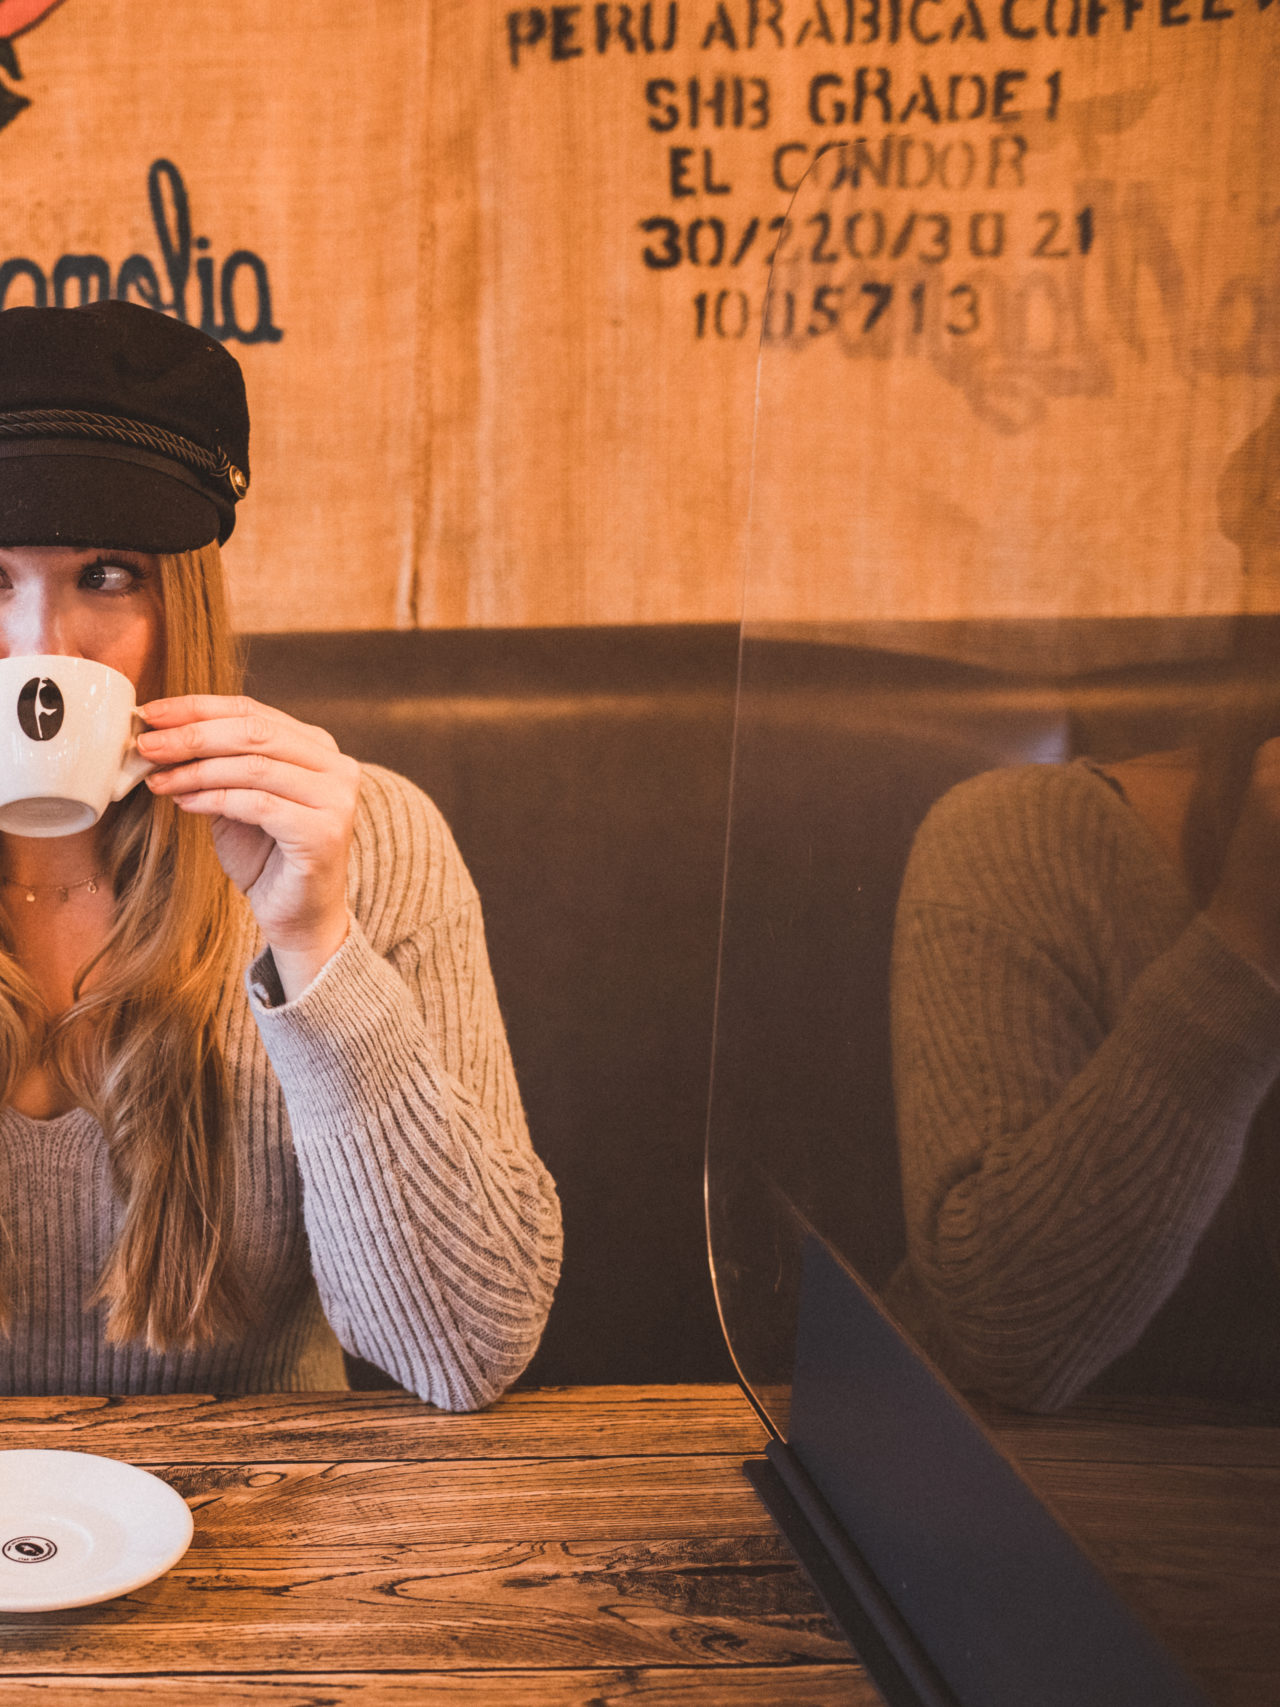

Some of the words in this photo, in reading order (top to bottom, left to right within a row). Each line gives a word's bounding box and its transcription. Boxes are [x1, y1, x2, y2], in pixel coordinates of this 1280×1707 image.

[506, 2, 677, 68] PERU
[700, 0, 988, 50] ARABICA
[644, 76, 770, 133] SHB
[808, 66, 1028, 126] GRADE
[668, 146, 732, 199] EL
[772, 134, 1028, 194] CONDOR
